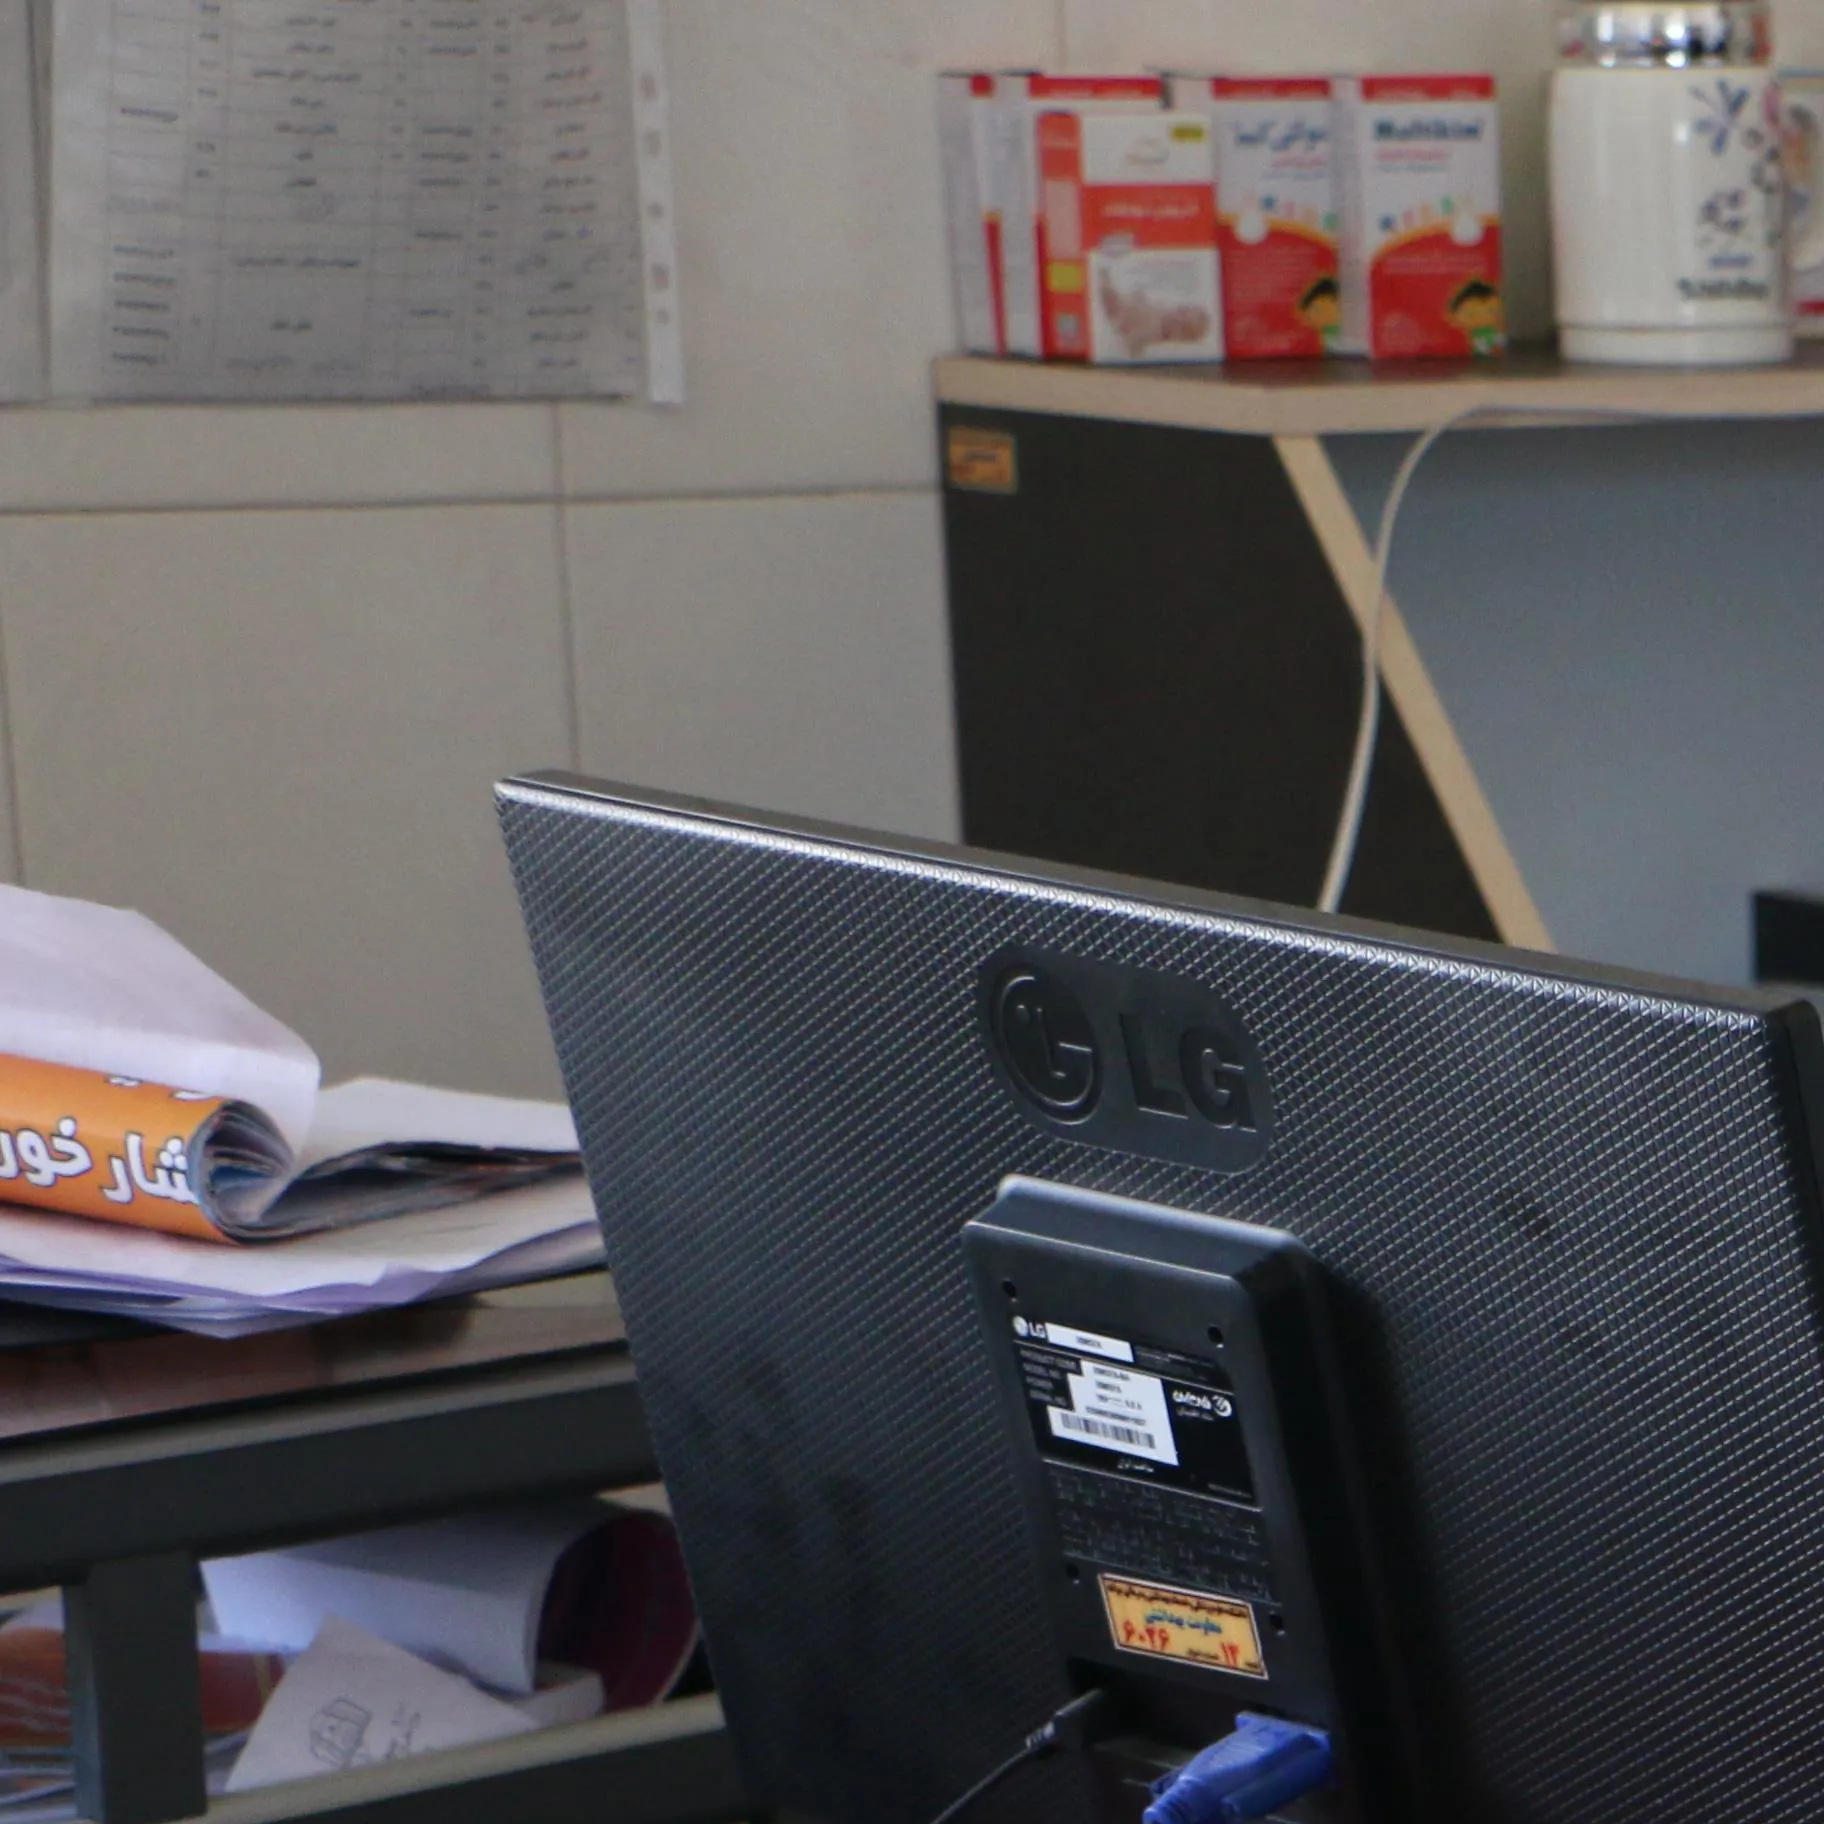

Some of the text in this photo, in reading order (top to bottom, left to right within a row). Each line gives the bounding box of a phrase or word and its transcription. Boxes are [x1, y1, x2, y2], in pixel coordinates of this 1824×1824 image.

[1119, 1011, 1257, 1133] LG
[101, 1131, 199, 1206] شار
[1028, 1321, 1046, 1339] LG
